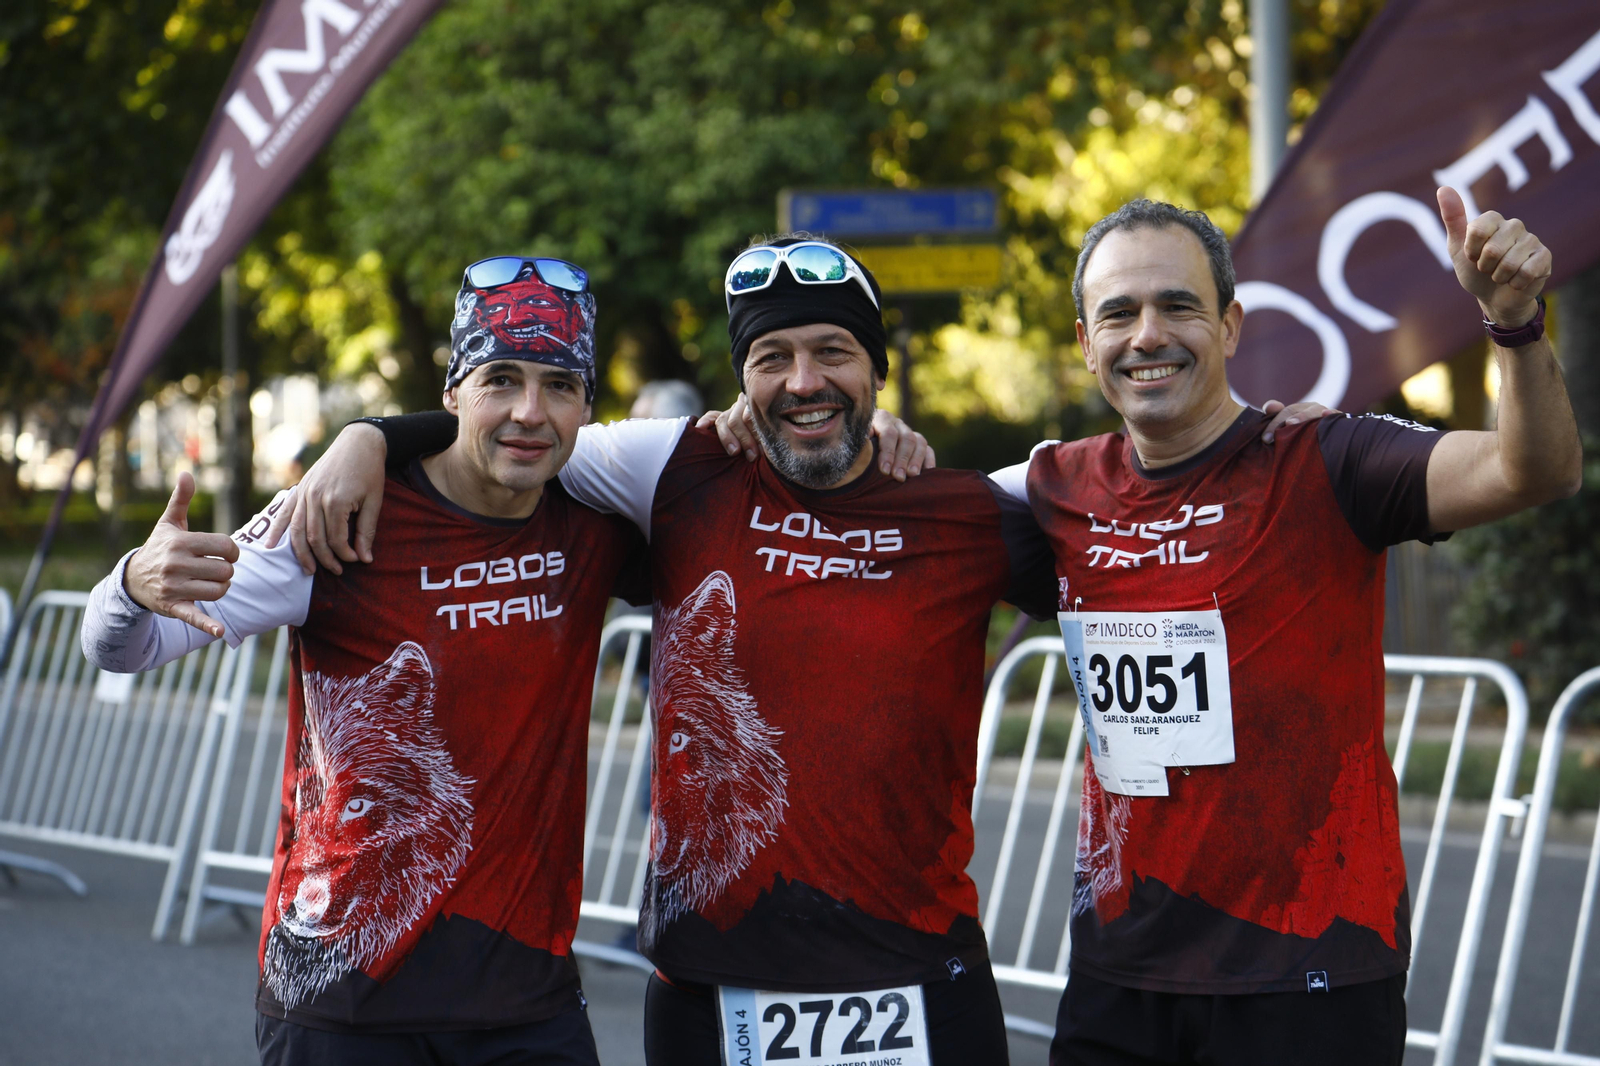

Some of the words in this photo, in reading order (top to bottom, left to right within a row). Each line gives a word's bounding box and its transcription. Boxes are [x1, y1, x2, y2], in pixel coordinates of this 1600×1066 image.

[223, 0, 380, 150] IM
[755, 546, 893, 580] TRAIL
[1085, 540, 1210, 568] TRAIL
[420, 551, 566, 590] LOBOS
[435, 593, 564, 631] TRAIL
[1100, 622, 1157, 638] IMDECO
[1163, 630, 1173, 638] 36
[1072, 655, 1080, 665] 4
[1089, 651, 1209, 714] 3051
[1103, 714, 1129, 724] CARLOS
[1130, 714, 1201, 724] SANZ-ARANGUEZ
[1133, 726, 1160, 735] FELIPE
[735, 1009, 747, 1019] 4
[762, 992, 914, 1061] 2722
[869, 1057, 902, 1066] MUÑOZ
